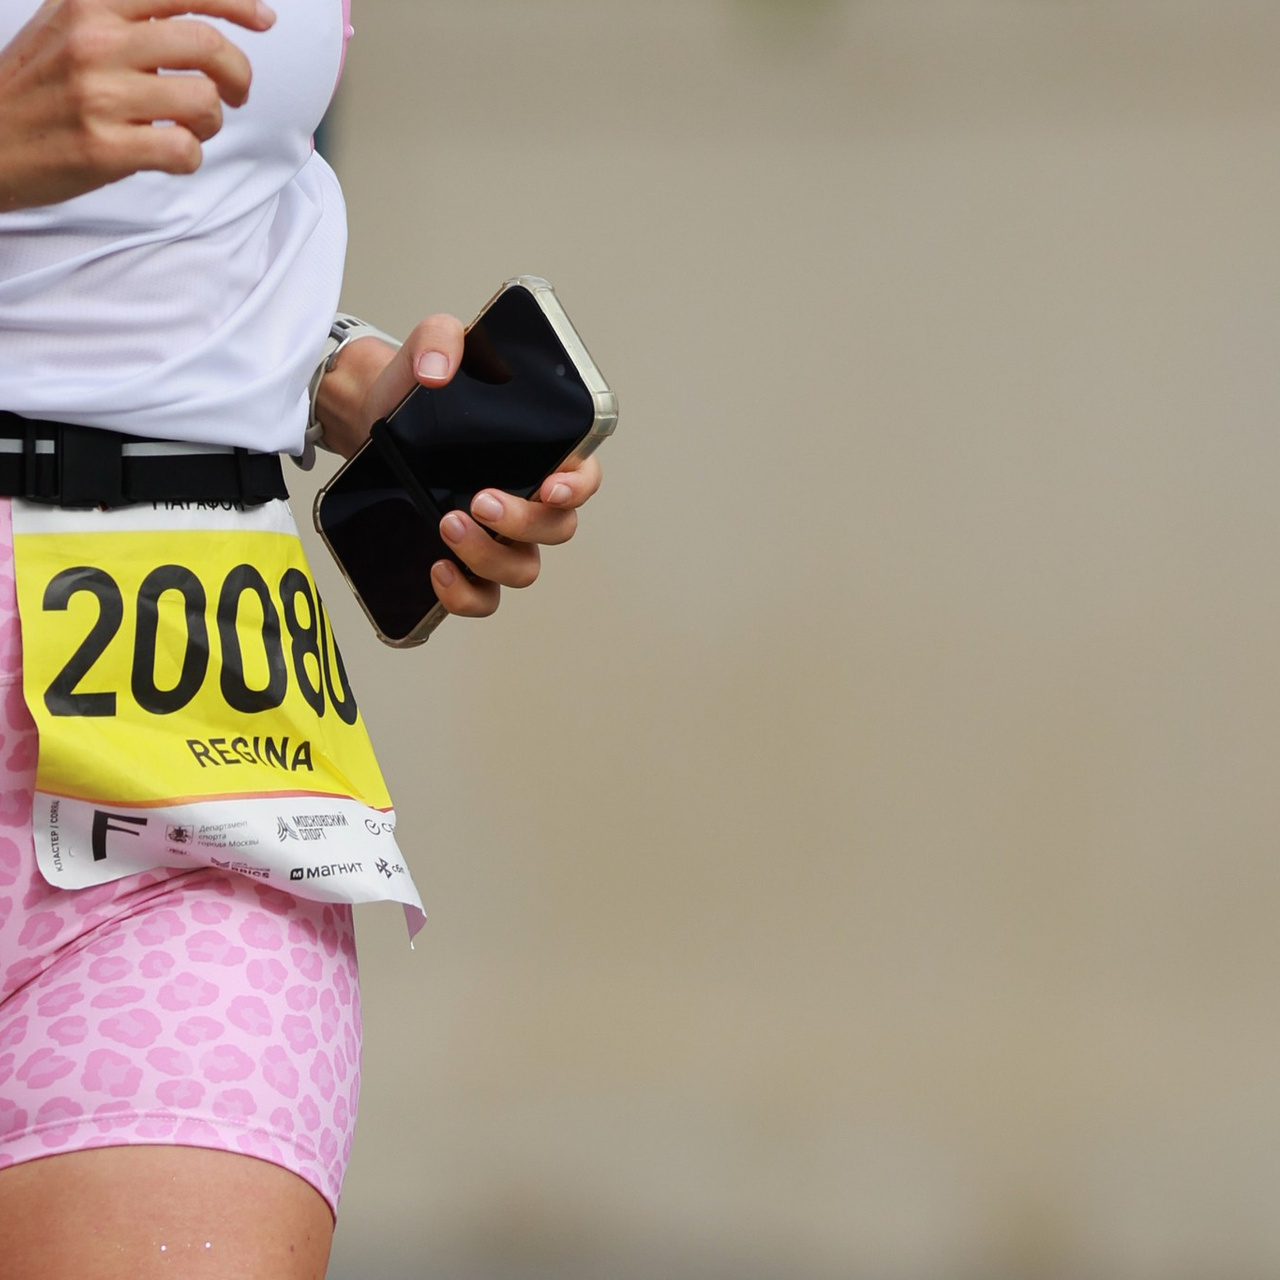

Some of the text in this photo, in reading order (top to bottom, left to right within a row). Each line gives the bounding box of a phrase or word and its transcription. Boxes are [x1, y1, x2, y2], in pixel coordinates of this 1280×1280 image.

[42, 563, 358, 726] 20080
[186, 736, 314, 772] REGINA
[92, 810, 148, 861] F
[291, 811, 350, 828] МОСКОВСКИЙ
[299, 828, 327, 841] СПОРТ
[50, 830, 64, 872] КЛАСТЕР
